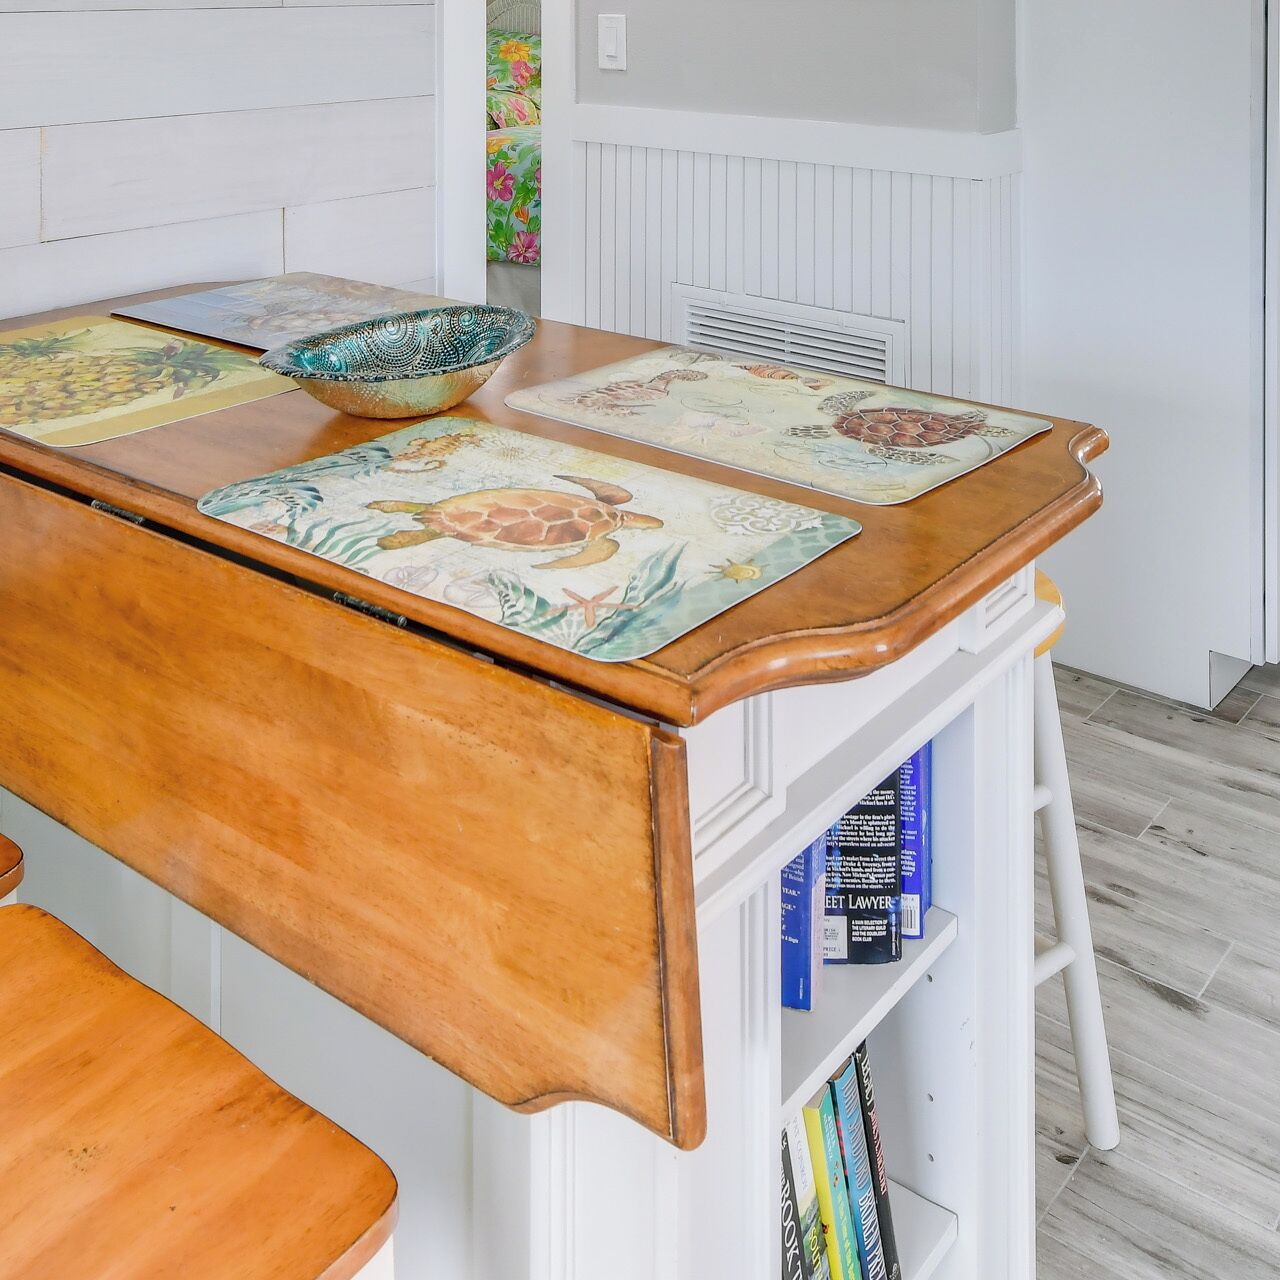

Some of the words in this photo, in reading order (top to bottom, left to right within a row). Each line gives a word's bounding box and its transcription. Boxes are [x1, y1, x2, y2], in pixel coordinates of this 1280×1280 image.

[824, 895, 845, 910] EET
[848, 893, 894, 910] LAWYER
[841, 1072, 860, 1120] JOHN
[848, 1111, 872, 1190] SANDFORD
[780, 1178, 800, 1273] BOOK
[859, 1183, 881, 1251] BROKEN
